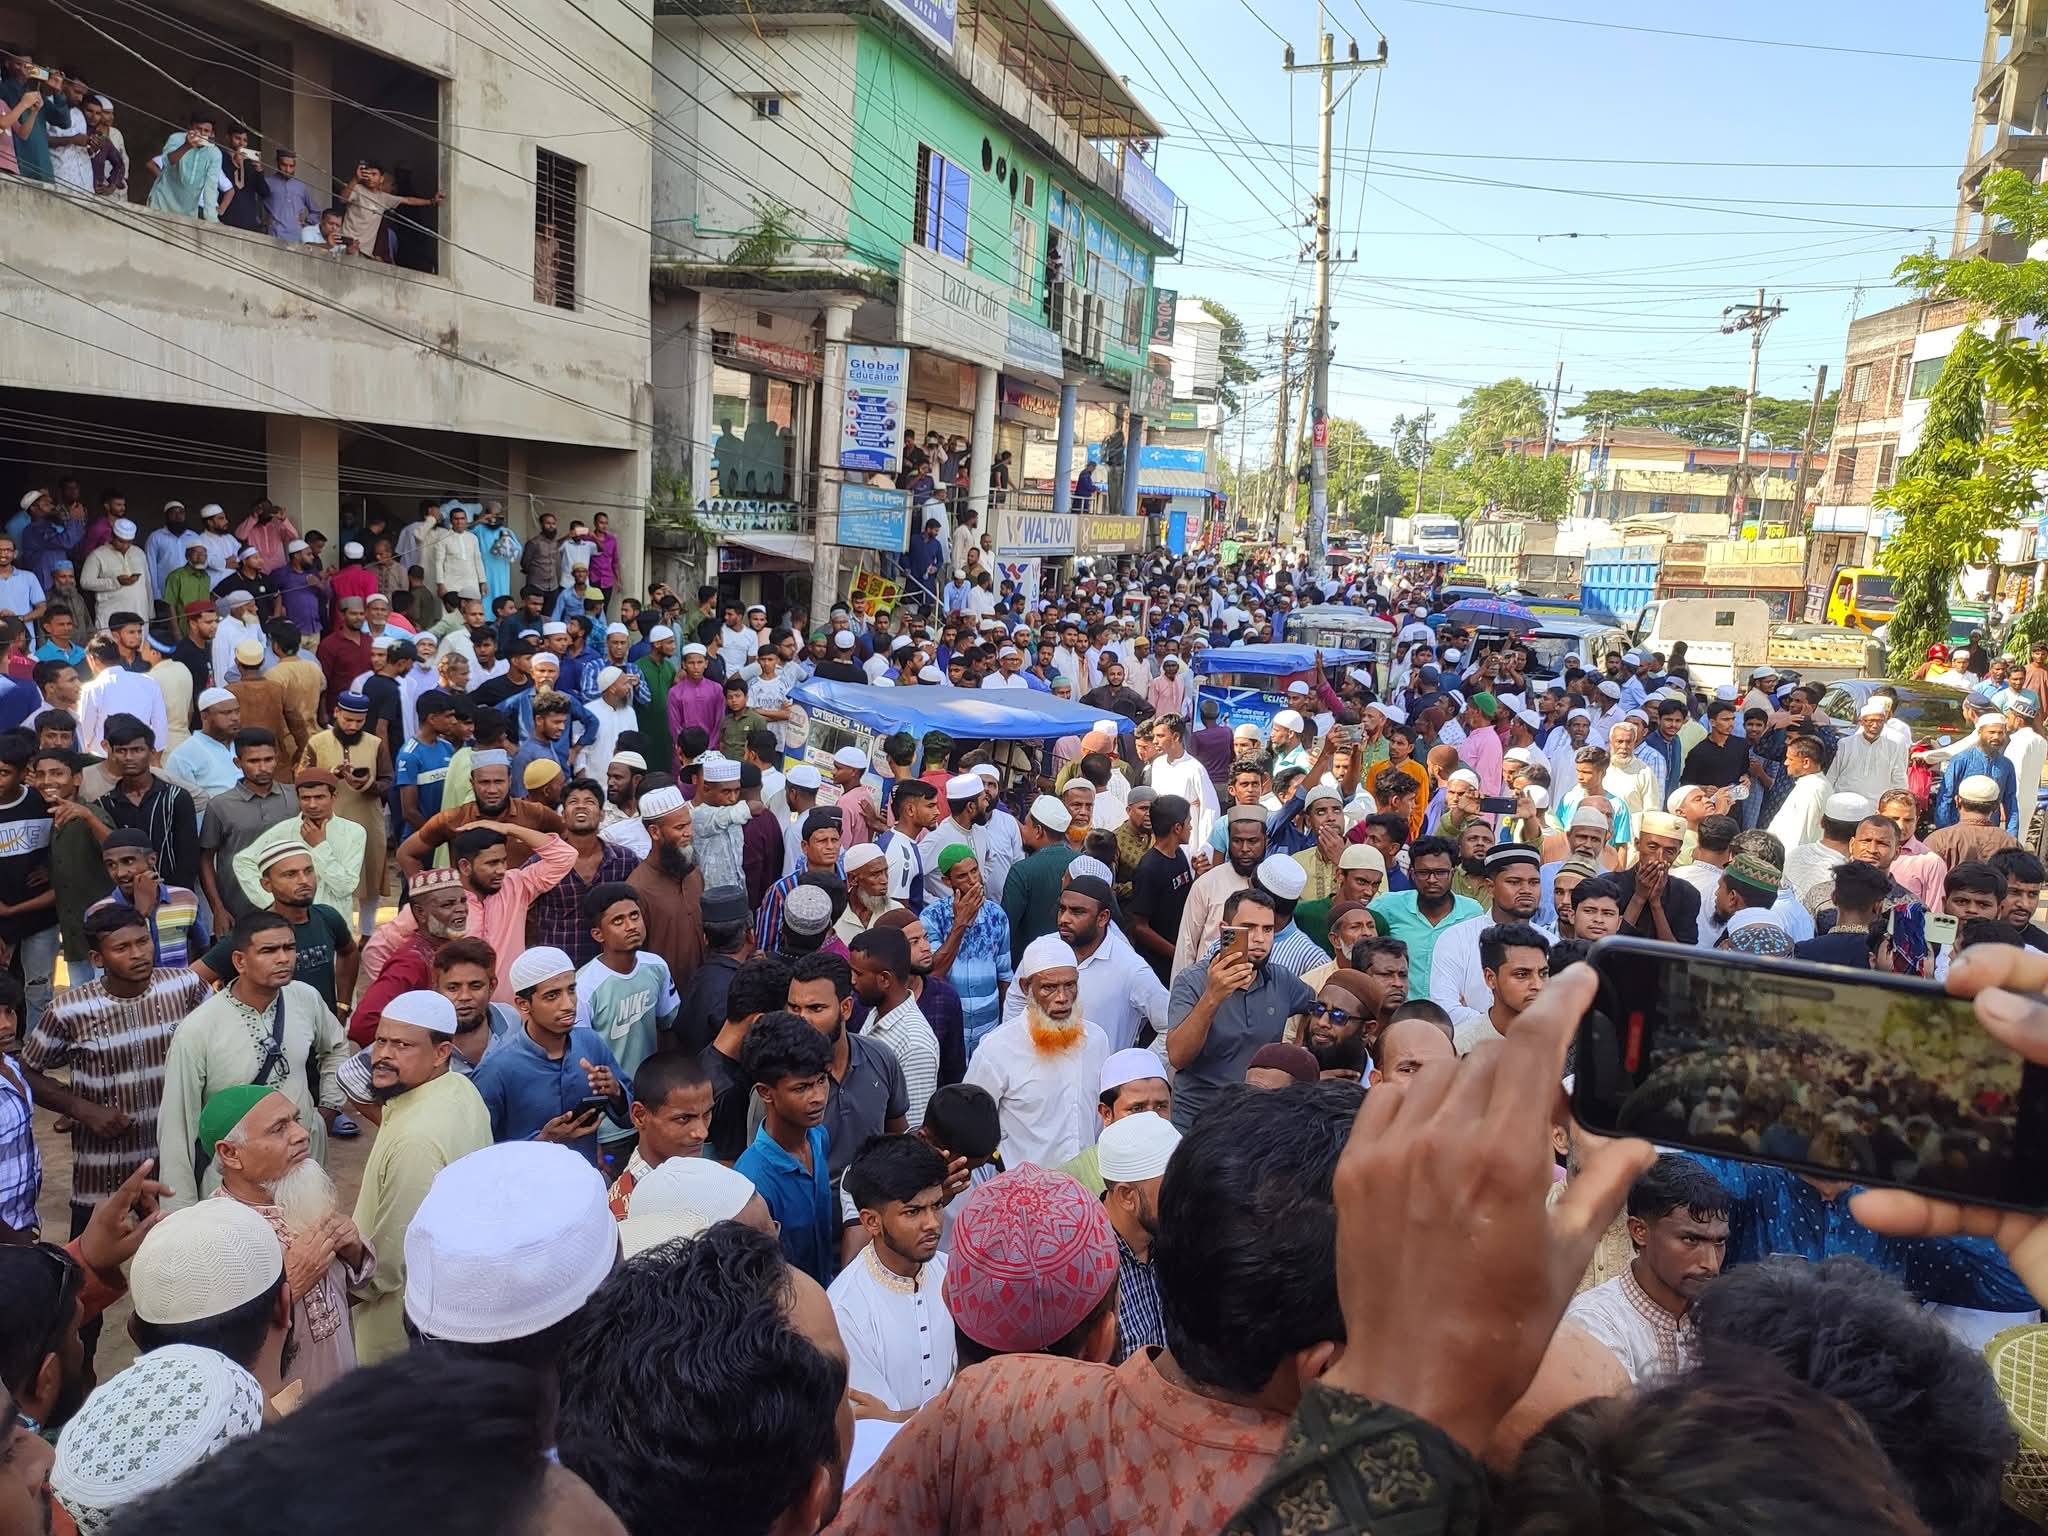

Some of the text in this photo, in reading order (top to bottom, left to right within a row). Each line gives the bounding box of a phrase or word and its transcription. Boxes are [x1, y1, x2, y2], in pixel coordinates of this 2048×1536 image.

[942, 270, 971, 311] Laziz
[849, 370, 899, 381] Education
[850, 359, 899, 371] Global
[1024, 516, 1072, 544] WALTON
[618, 989, 650, 1022] NIKE
